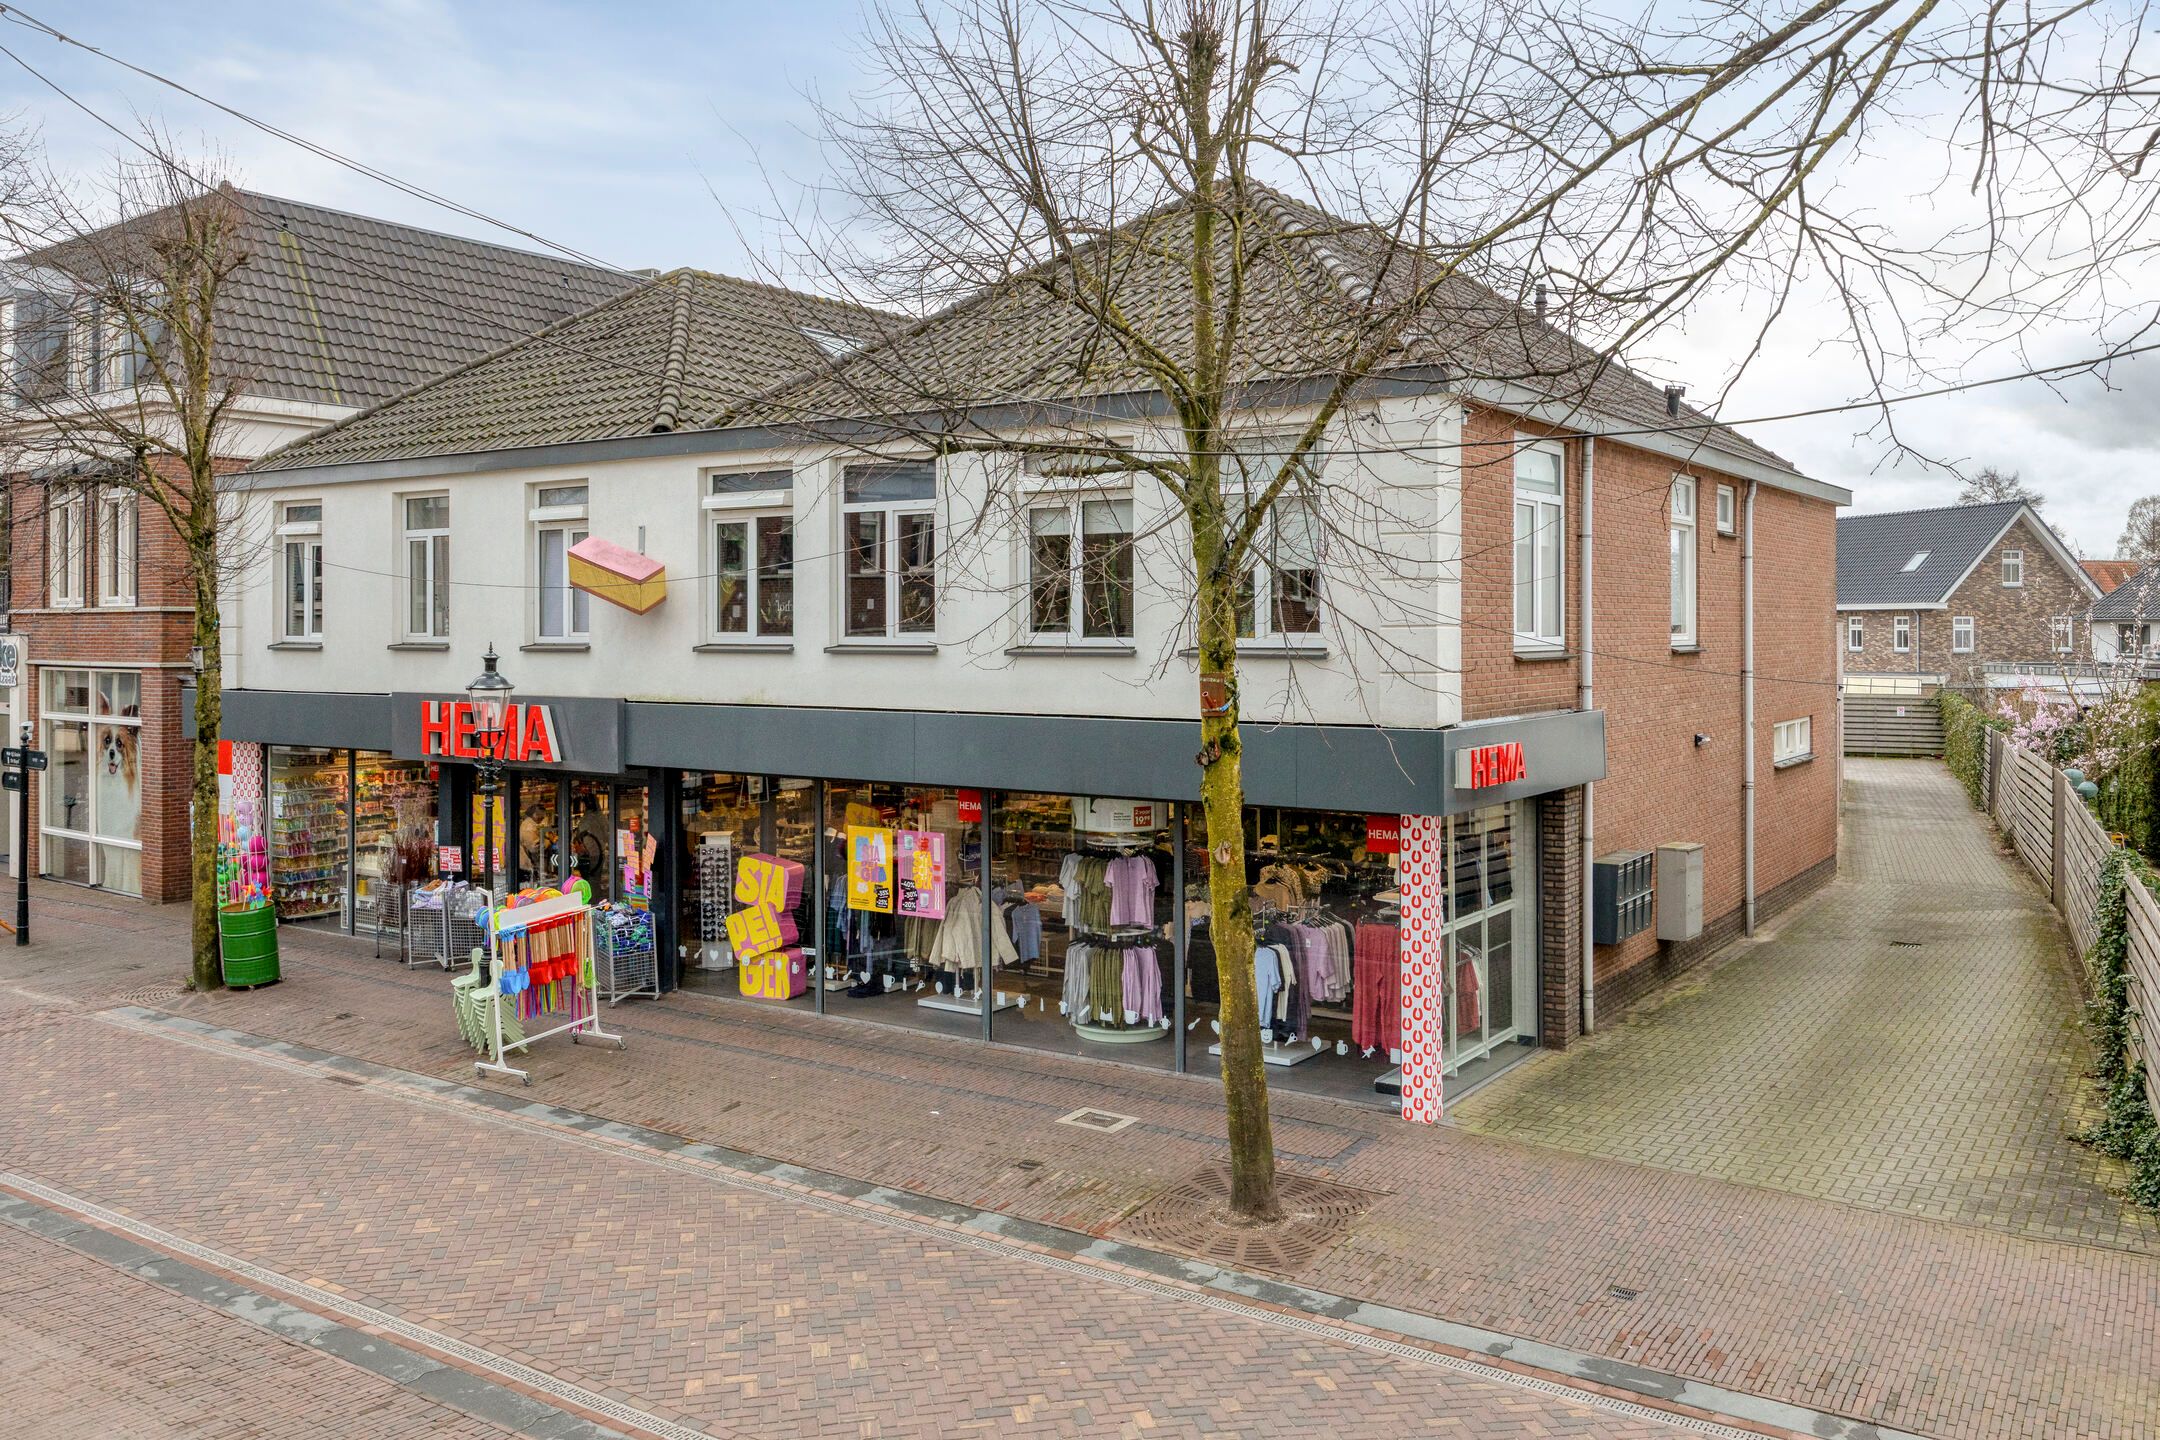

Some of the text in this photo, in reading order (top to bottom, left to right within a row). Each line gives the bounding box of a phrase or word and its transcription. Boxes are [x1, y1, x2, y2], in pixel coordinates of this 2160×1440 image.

[421, 700, 557, 763] HEMA
[1471, 742, 1527, 790] HEMA
[959, 801, 982, 811] HEMA
[1368, 829, 1399, 841] HEMA
[735, 856, 785, 913] STA
[726, 902, 782, 952] PEL
